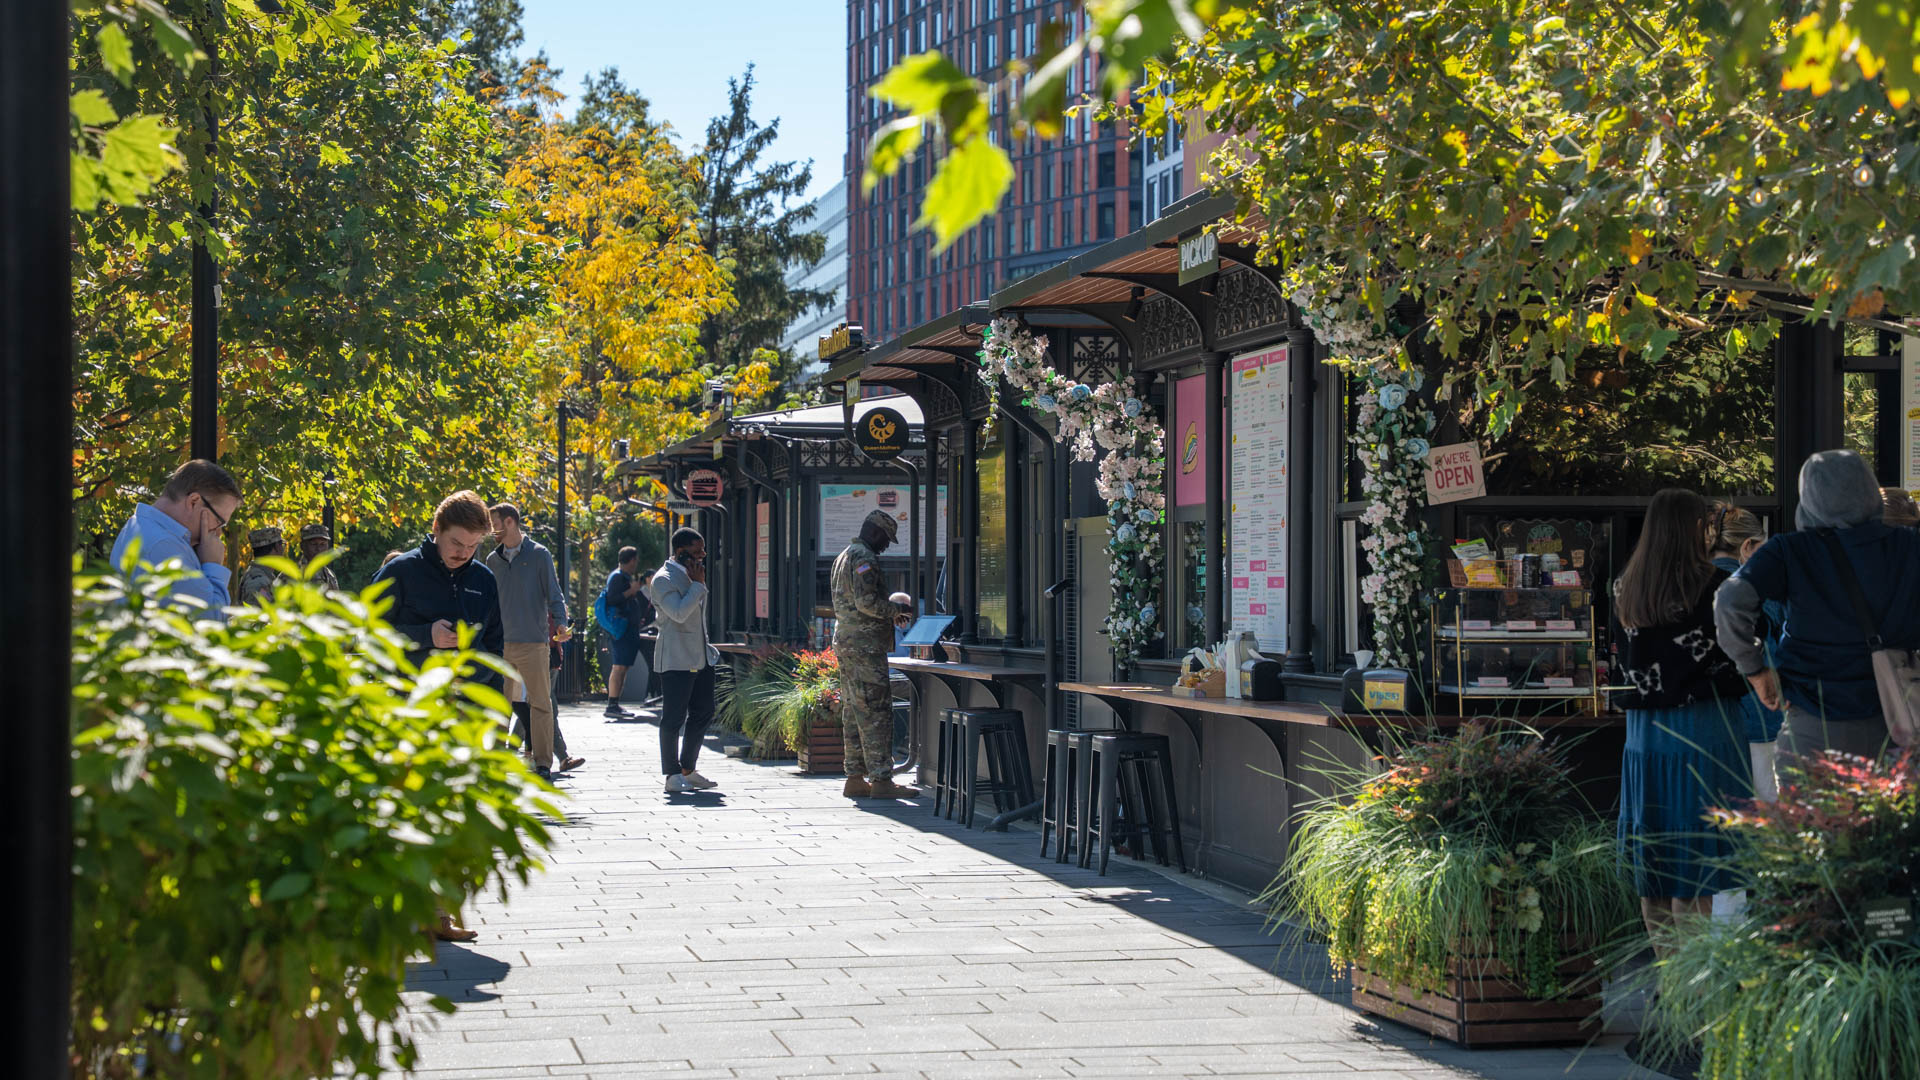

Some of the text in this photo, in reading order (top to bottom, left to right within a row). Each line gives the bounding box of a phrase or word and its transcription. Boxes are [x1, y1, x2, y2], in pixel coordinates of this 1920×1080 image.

[1181, 232, 1215, 271] PICKUP
[1442, 451, 1471, 465] WE'RE
[1434, 464, 1475, 489] OPEN
